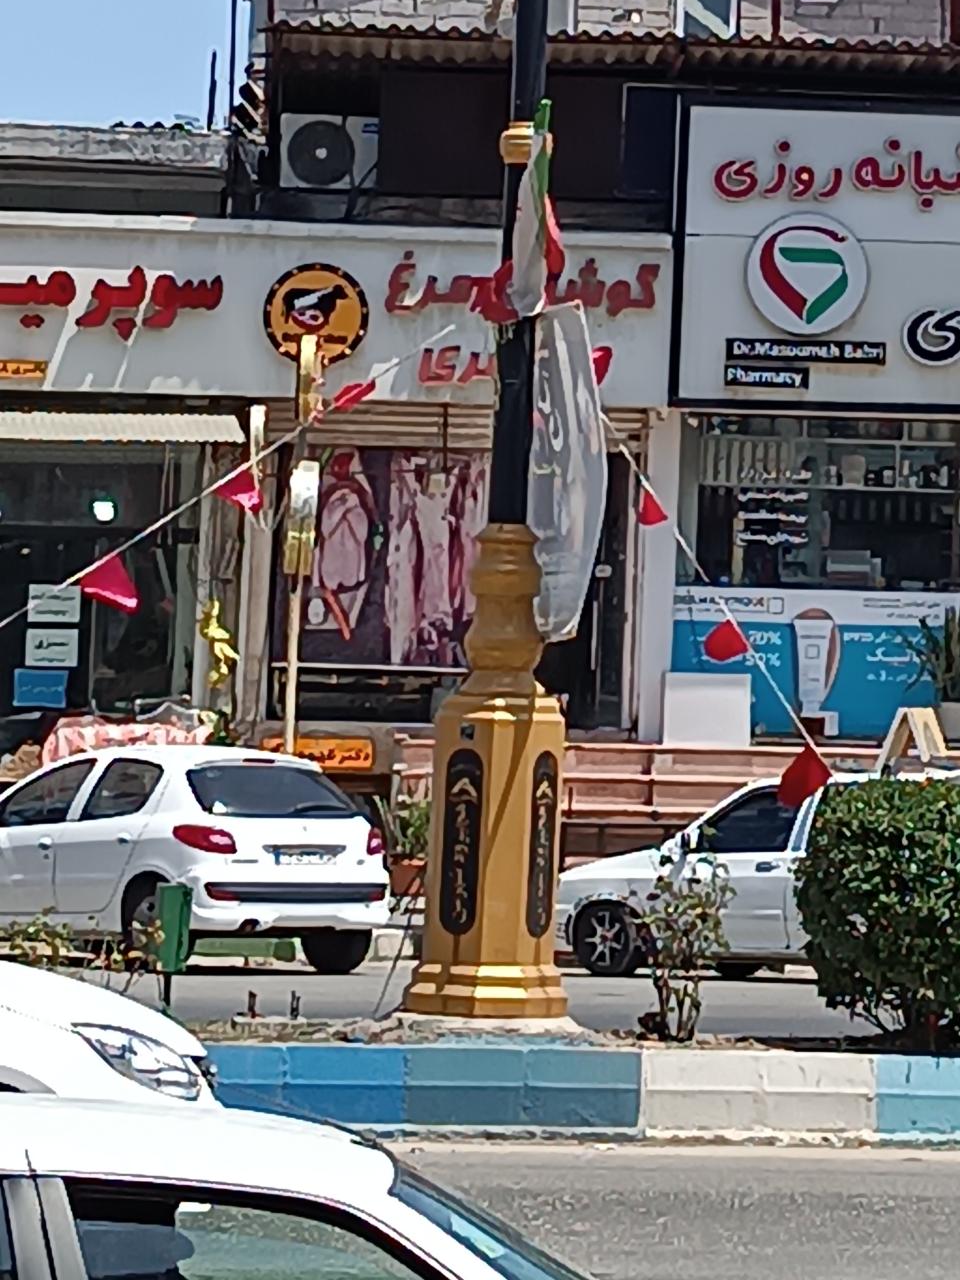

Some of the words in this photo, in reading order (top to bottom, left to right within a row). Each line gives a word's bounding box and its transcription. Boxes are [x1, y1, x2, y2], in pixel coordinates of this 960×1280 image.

[713, 139, 842, 201] روزی
[0, 270, 77, 329] می
[75, 265, 224, 342] سوپر
[726, 367, 804, 388] Pharmacy
